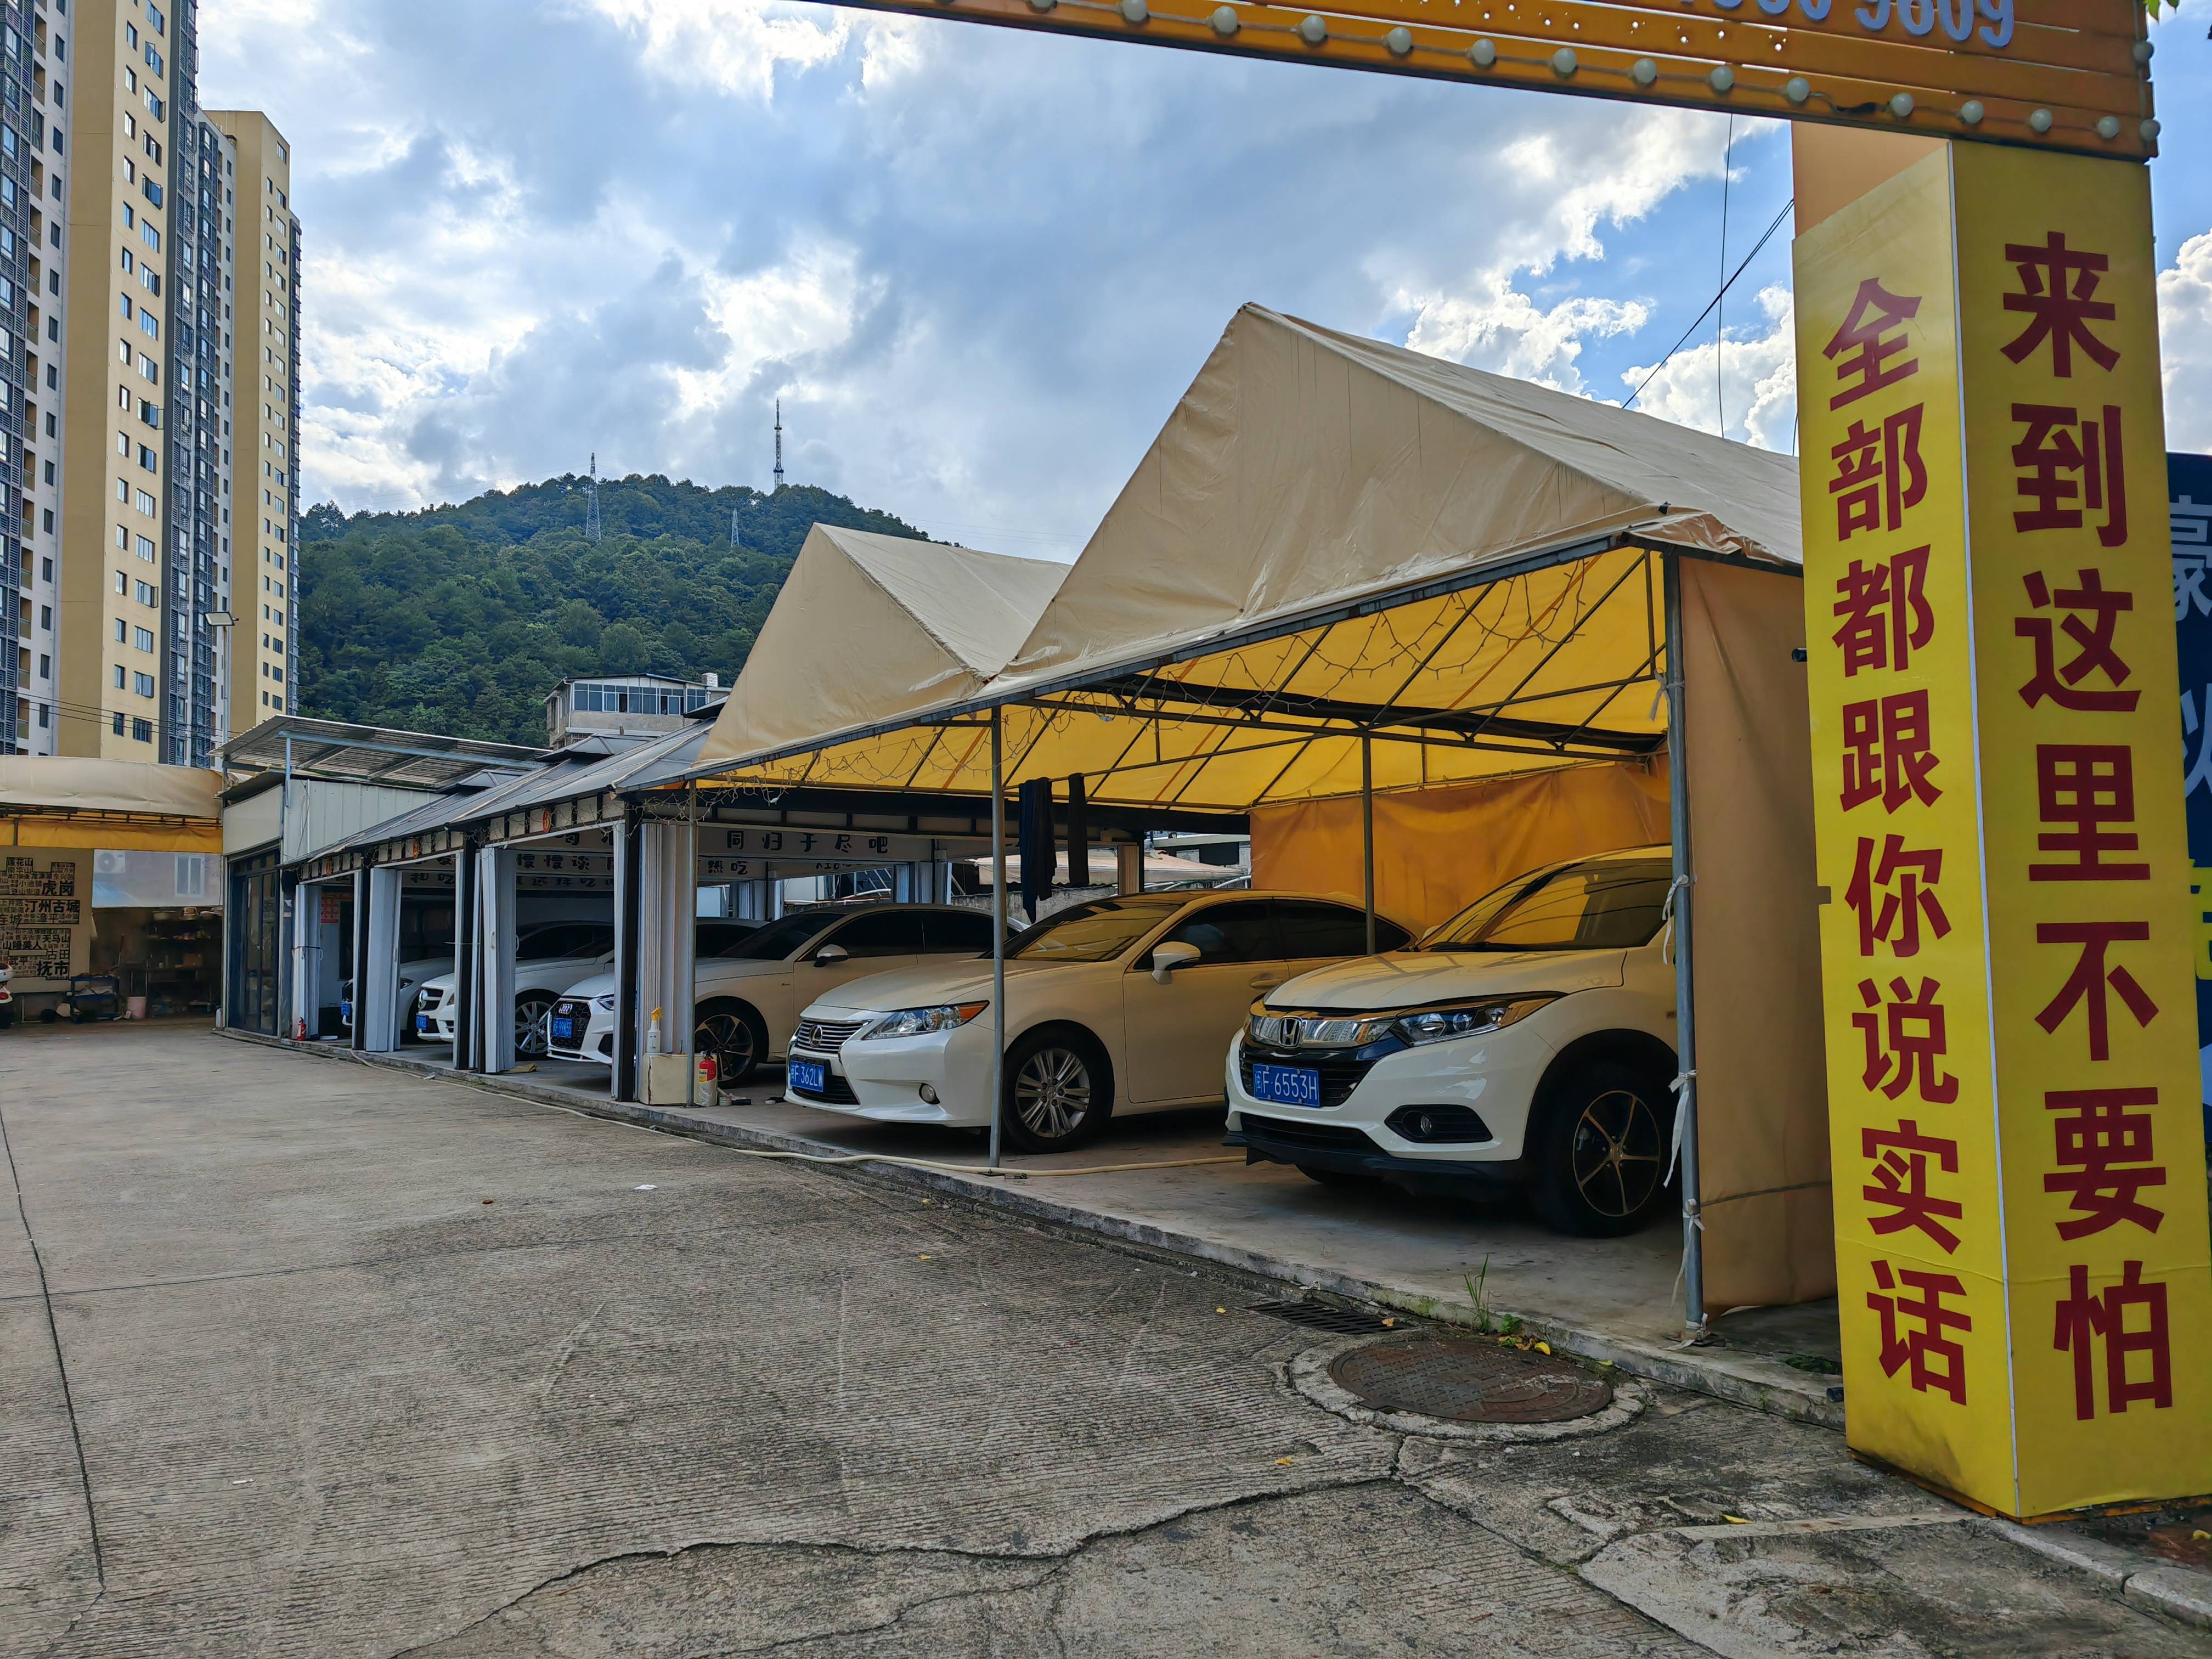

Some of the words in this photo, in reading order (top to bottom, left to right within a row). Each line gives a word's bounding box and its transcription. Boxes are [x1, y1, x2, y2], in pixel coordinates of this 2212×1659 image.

[2000, 230, 2172, 1421] 来到这里不要怕
[727, 830, 888, 854] 同归于尽吧
[1822, 276, 1972, 1406] 全部都跟你说实话
[25, 900, 79, 912] 汀州古城
[43, 933, 70, 943] 天马山
[47, 949, 70, 960] 古田
[36, 960, 70, 976] 抚市
